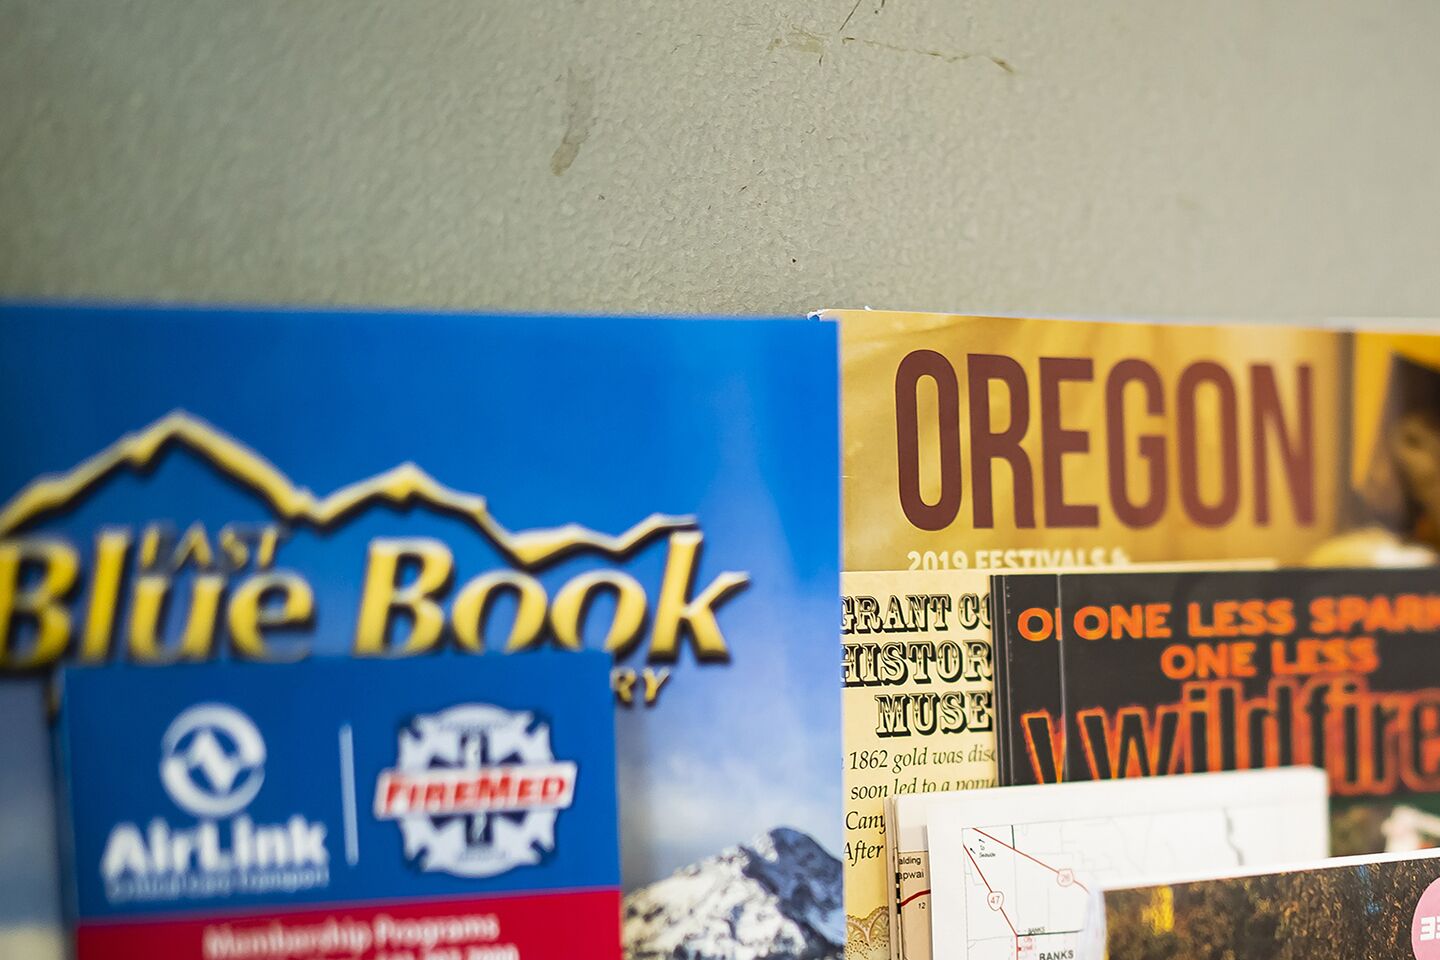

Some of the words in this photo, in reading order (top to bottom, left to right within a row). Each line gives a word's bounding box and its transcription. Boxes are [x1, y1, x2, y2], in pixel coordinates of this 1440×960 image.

[895, 349, 1319, 531] OREGON
[907, 550, 968, 571] 2019
[975, 548, 1104, 570] FESTIVALS
[0, 527, 314, 664] Blue
[354, 530, 752, 660] Book
[840, 594, 950, 635] GRANT
[1073, 603, 1172, 641] ONE
[1187, 600, 1297, 638] LESS
[1160, 641, 1257, 680] ONE
[1271, 637, 1380, 675] LESS
[874, 690, 993, 738] MUSE
[849, 749, 888, 770] 1862
[892, 746, 928, 774] gold
[932, 753, 963, 766] was
[850, 783, 888, 800] soon
[893, 777, 917, 796] led
[101, 815, 329, 882] AirLink
[843, 840, 884, 867] After
[990, 895, 1001, 904] 47
